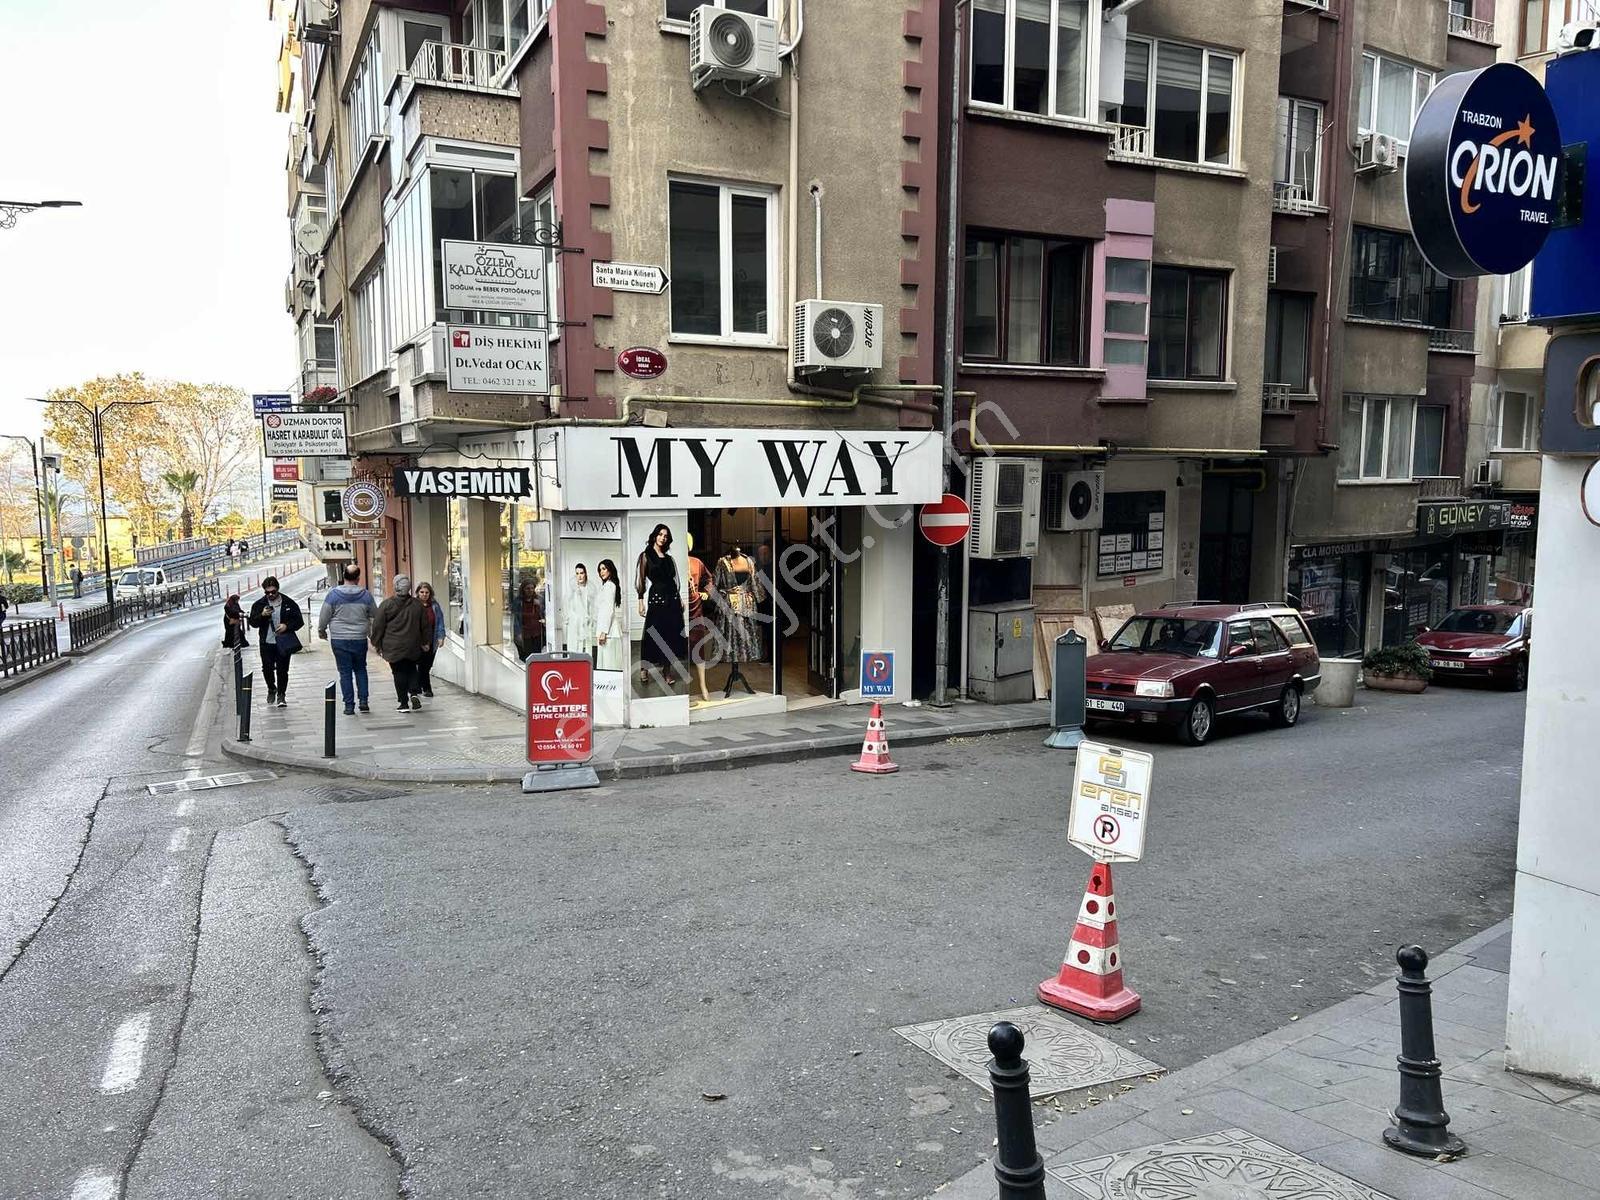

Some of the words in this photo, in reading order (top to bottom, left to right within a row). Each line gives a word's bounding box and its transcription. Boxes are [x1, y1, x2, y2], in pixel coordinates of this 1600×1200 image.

[1462, 109, 1502, 129] TRABZON
[1451, 139, 1558, 201] ORION
[1519, 208, 1549, 225] TRAVEL
[475, 254, 515, 269] ÖZLEM
[448, 263, 541, 280] KADAKALOĞLU
[595, 265, 614, 275] Santa
[615, 267, 633, 277] Maria
[633, 269, 657, 278] Kilisesi
[450, 283, 475, 292] DOĞUM
[482, 285, 500, 293] BEBEK
[596, 276, 609, 285] (St.
[610, 276, 629, 287] Maria
[630, 278, 657, 290] Church)
[474, 335, 494, 349] DİŞ
[497, 337, 542, 350] HEKİMİ
[505, 359, 543, 371] OCAK
[462, 376, 480, 385] TEL:
[482, 377, 500, 386] 0462
[283, 418, 311, 427] UZMAN
[312, 417, 343, 426] DOKTOR
[266, 429, 291, 441] HASRET
[292, 429, 330, 441] KARABULUT
[331, 427, 344, 440] GÜL
[609, 436, 734, 499] MY
[756, 438, 910, 499] WAY
[565, 520, 588, 532] MY
[589, 520, 619, 534] WAY
[863, 685, 875, 693] MY
[876, 685, 892, 693] WAY
[532, 704, 588, 713] HACETTEPE
[1111, 701, 1124, 711] 440
